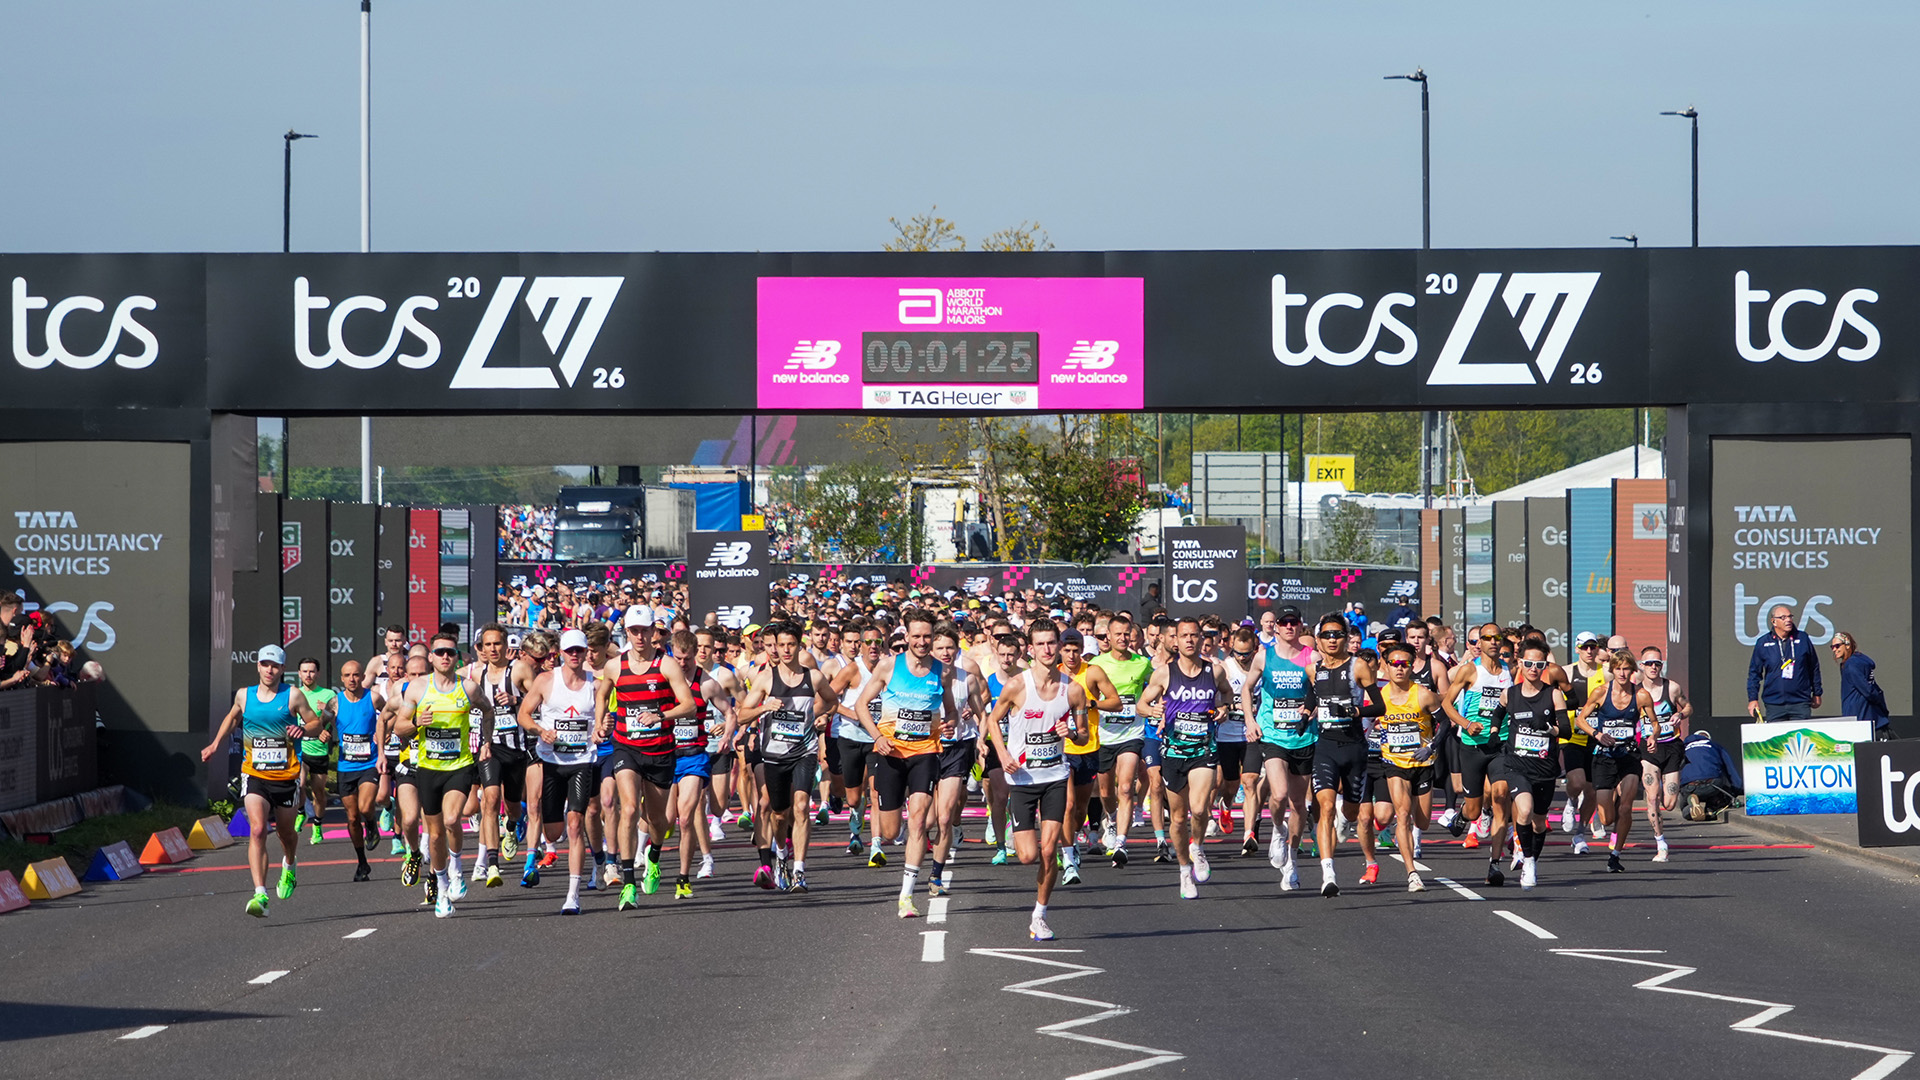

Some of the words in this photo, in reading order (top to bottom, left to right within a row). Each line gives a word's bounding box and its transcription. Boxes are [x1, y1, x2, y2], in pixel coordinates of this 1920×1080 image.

[448, 277, 480, 297] 20
[1426, 274, 1457, 294] 20
[947, 289, 985, 297] ABBOTT
[947, 298, 983, 306] WORLD
[947, 307, 1002, 315] MARATHON
[947, 316, 986, 324] MAJORS
[1272, 274, 1417, 366] tcs
[1735, 271, 1880, 362] tcs
[13, 277, 158, 369] tcs
[295, 277, 440, 369] tcs
[593, 368, 624, 388] 26
[773, 375, 797, 383] new
[800, 373, 850, 383] balance
[1051, 375, 1075, 383] new
[1078, 373, 1128, 383] balance
[1571, 363, 1602, 383] 26
[1317, 468, 1345, 479] EXIT
[1734, 505, 1797, 522] TATA
[14, 511, 78, 528] TATA
[1734, 528, 1881, 545] CONSULTANCY
[14, 534, 163, 551] CONSULTANCY
[1172, 540, 1200, 549] TATA
[1172, 550, 1238, 559] CONSULTANCY
[1172, 560, 1215, 569] SERVICES
[1733, 551, 1829, 569] SERVICES
[14, 557, 110, 575] SERVICES
[697, 569, 717, 578] new
[718, 568, 759, 578] balance
[1172, 574, 1218, 602] tcs
[1248, 579, 1278, 600] tcs
[1282, 586, 1327, 594] CONSULTANCY
[899, 709, 912, 719] tcs
[1177, 712, 1190, 720] tcs
[1384, 712, 1420, 720] BOSTON
[556, 721, 568, 730] tcs
[254, 738, 266, 747] tcs
[559, 734, 582, 742] 51207
[1027, 734, 1042, 744] tcs
[1392, 736, 1414, 744] 51220
[1520, 738, 1544, 748] 52624
[430, 742, 455, 750] 51920
[1032, 746, 1058, 756] 48858
[257, 752, 282, 760] 45174
[1765, 764, 1852, 789] BUXTON
